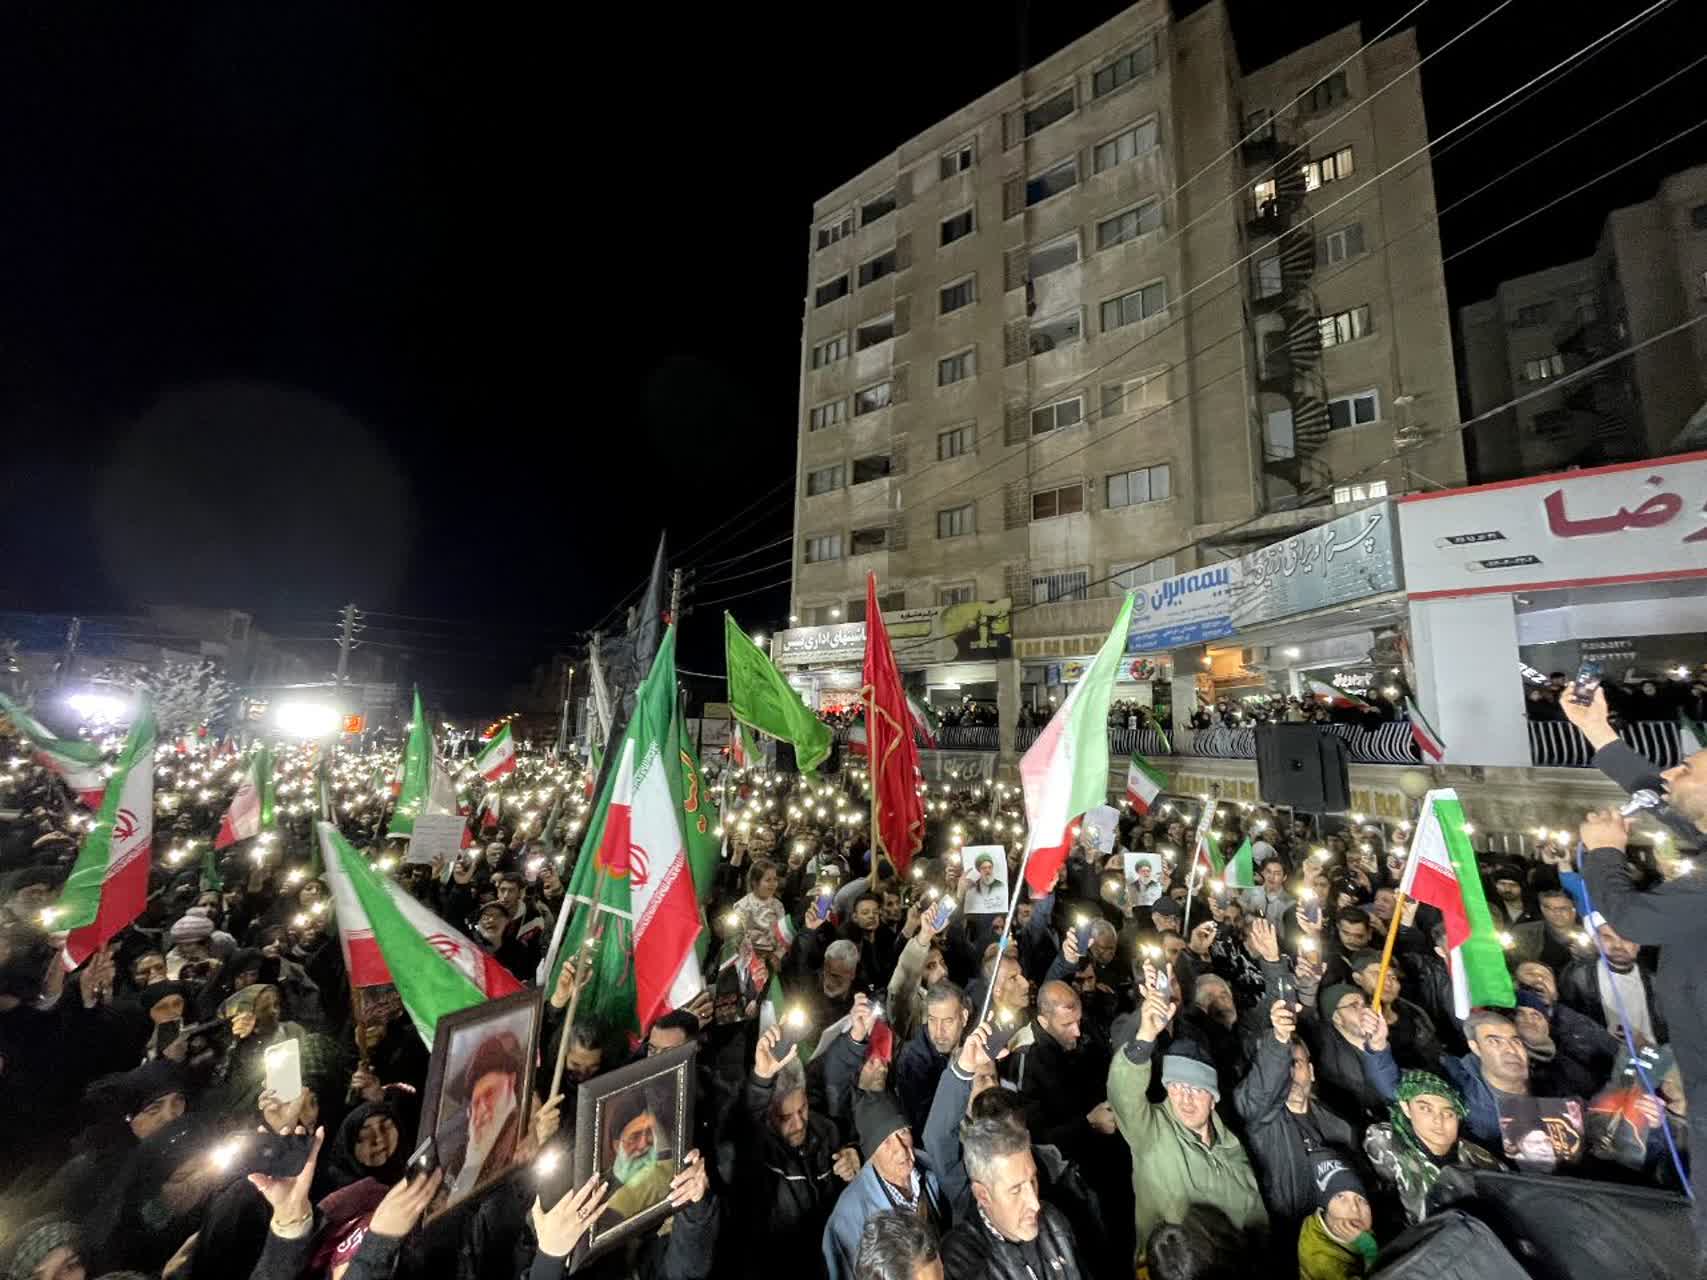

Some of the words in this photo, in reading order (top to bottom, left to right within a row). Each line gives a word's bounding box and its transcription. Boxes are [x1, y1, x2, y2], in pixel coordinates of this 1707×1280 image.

[1150, 577, 1186, 611] ایران
[1186, 566, 1232, 598] بیمه
[829, 626, 868, 649] اشینهای
